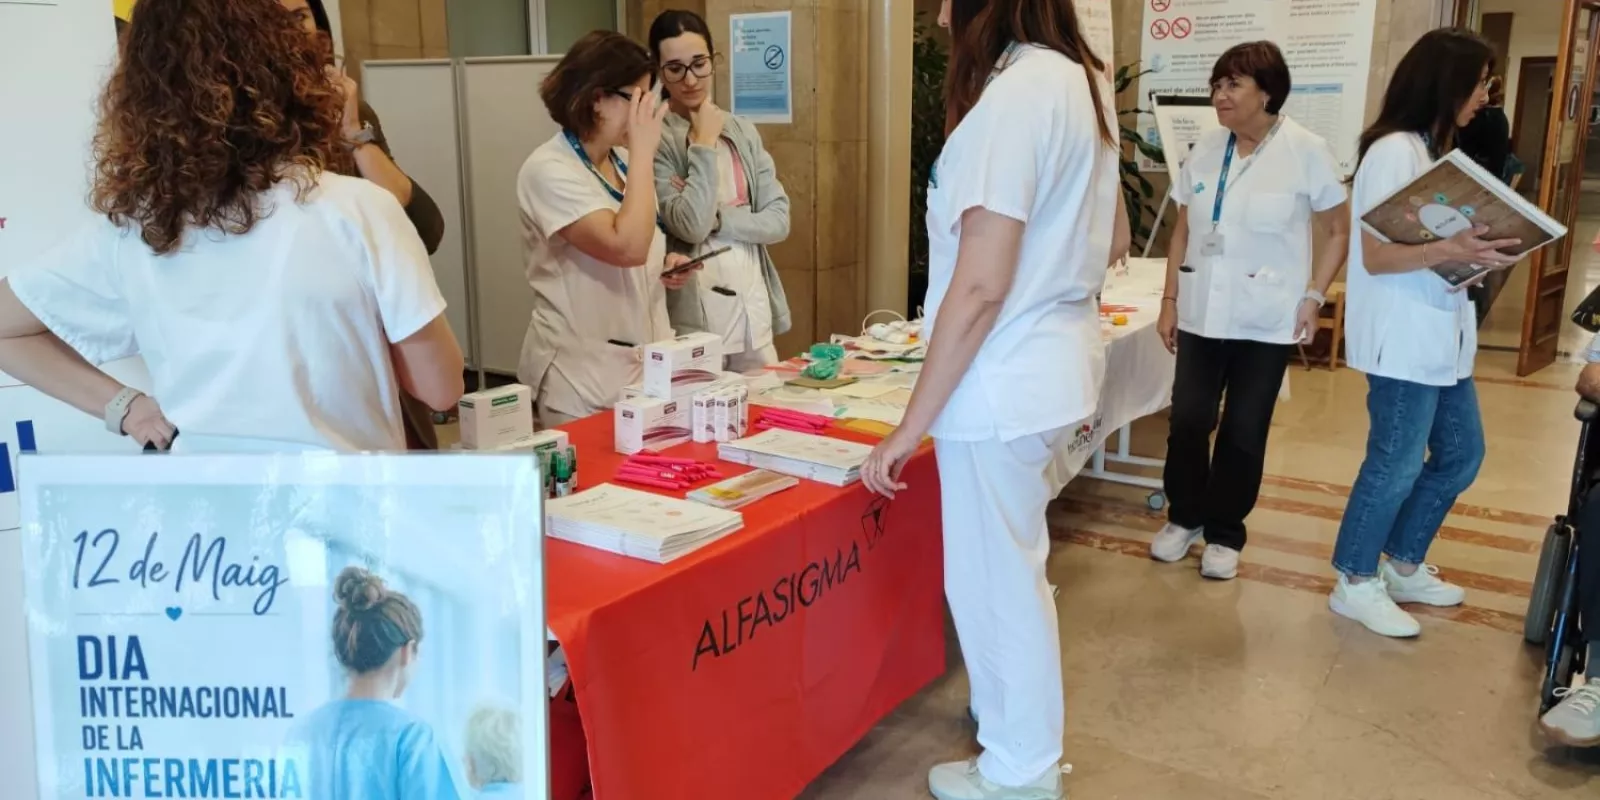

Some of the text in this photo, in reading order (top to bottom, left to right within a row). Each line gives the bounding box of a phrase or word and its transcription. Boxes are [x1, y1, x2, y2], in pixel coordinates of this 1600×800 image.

[72, 528, 289, 616] 12 de Maig
[692, 540, 861, 672] ALFASIGMA
[77, 634, 149, 681] DIA
[80, 686, 294, 718] INTERNACIONAL
[82, 724, 144, 751] DE LA
[84, 757, 303, 799] INFERMERIA
